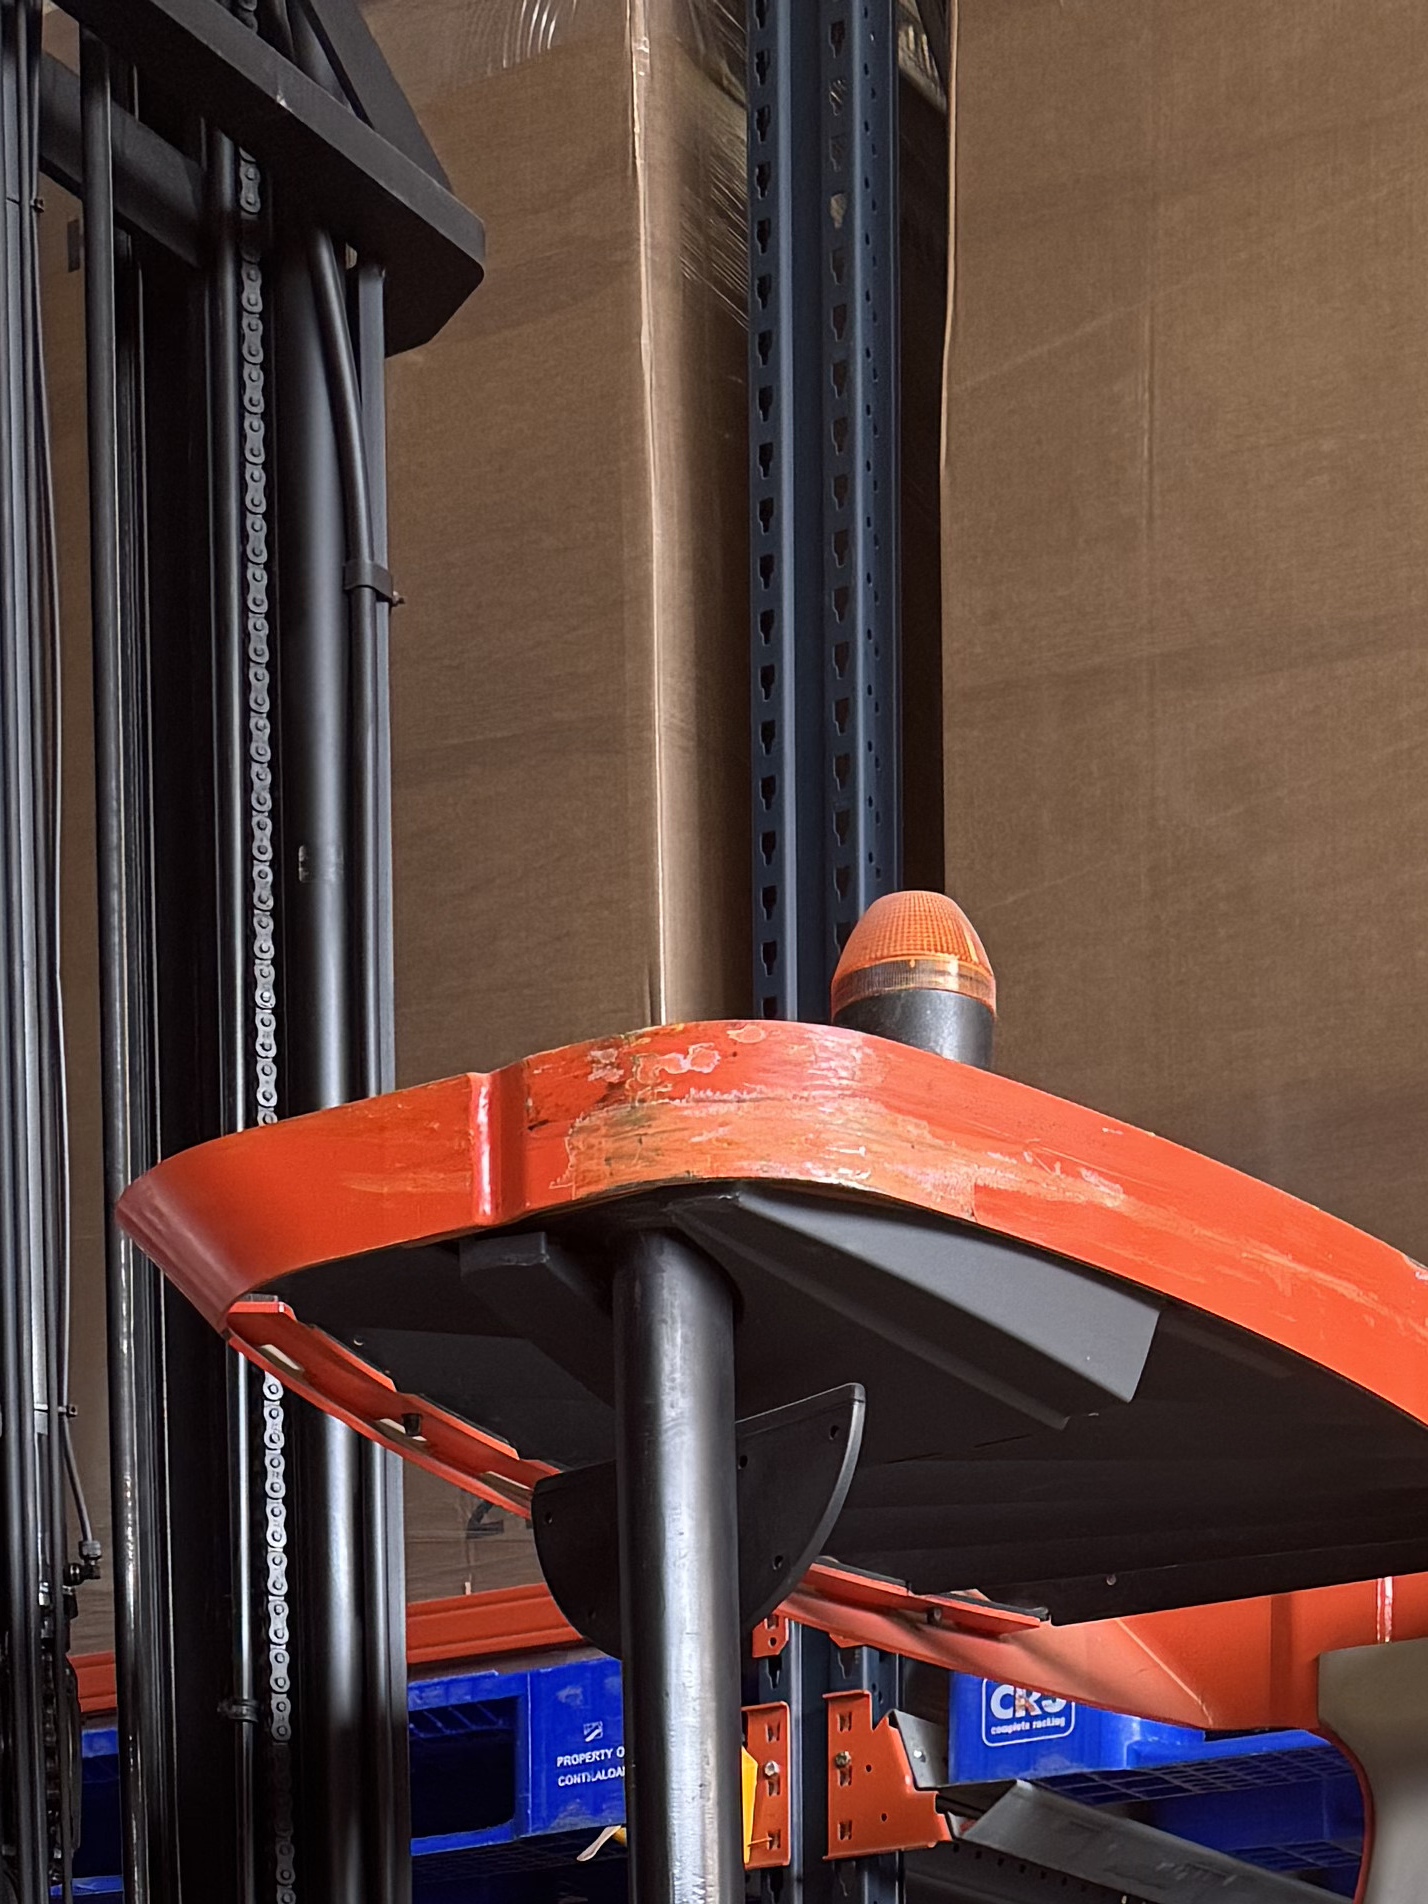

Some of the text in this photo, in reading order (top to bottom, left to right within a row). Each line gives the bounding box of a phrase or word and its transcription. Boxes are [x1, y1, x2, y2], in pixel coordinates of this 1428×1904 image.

[991, 1716, 1066, 1735] complete racking
[557, 1748, 613, 1767] PROPERTY
